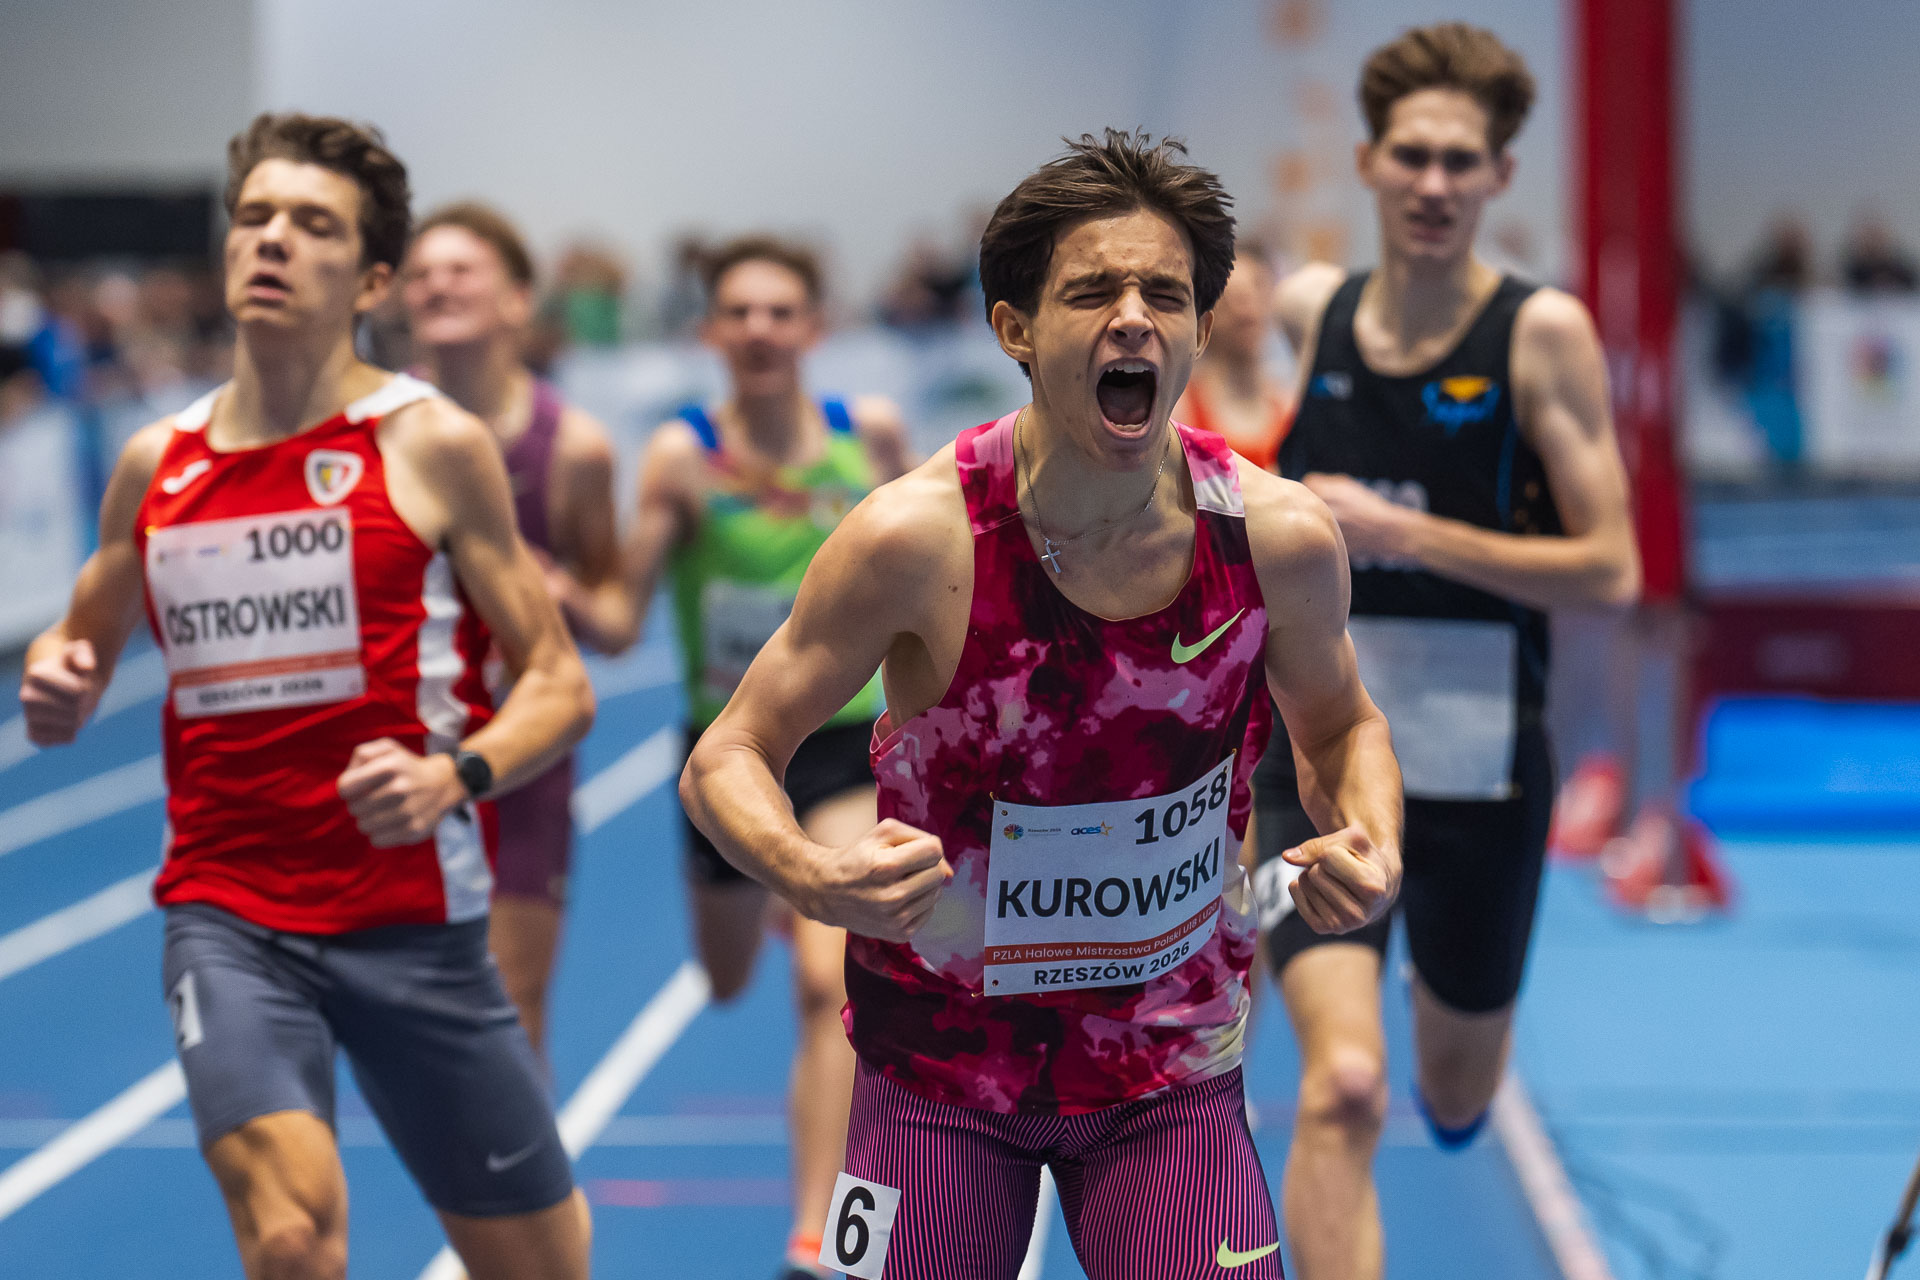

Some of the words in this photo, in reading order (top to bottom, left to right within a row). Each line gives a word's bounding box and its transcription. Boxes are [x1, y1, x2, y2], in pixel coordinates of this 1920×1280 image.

[247, 518, 344, 562] 1000
[1134, 769, 1228, 845] 1058
[1071, 826, 1102, 836] aces
[997, 837, 1220, 918] KUROWSKI
[993, 950, 1022, 961] PZLA
[1025, 947, 1073, 959] Halowe
[1076, 944, 1151, 956] Mistrzostwa
[1154, 928, 1182, 950] Polski
[1034, 962, 1145, 986] RZESZÓW
[1149, 941, 1190, 974] 2026
[835, 1186, 876, 1267] 6
